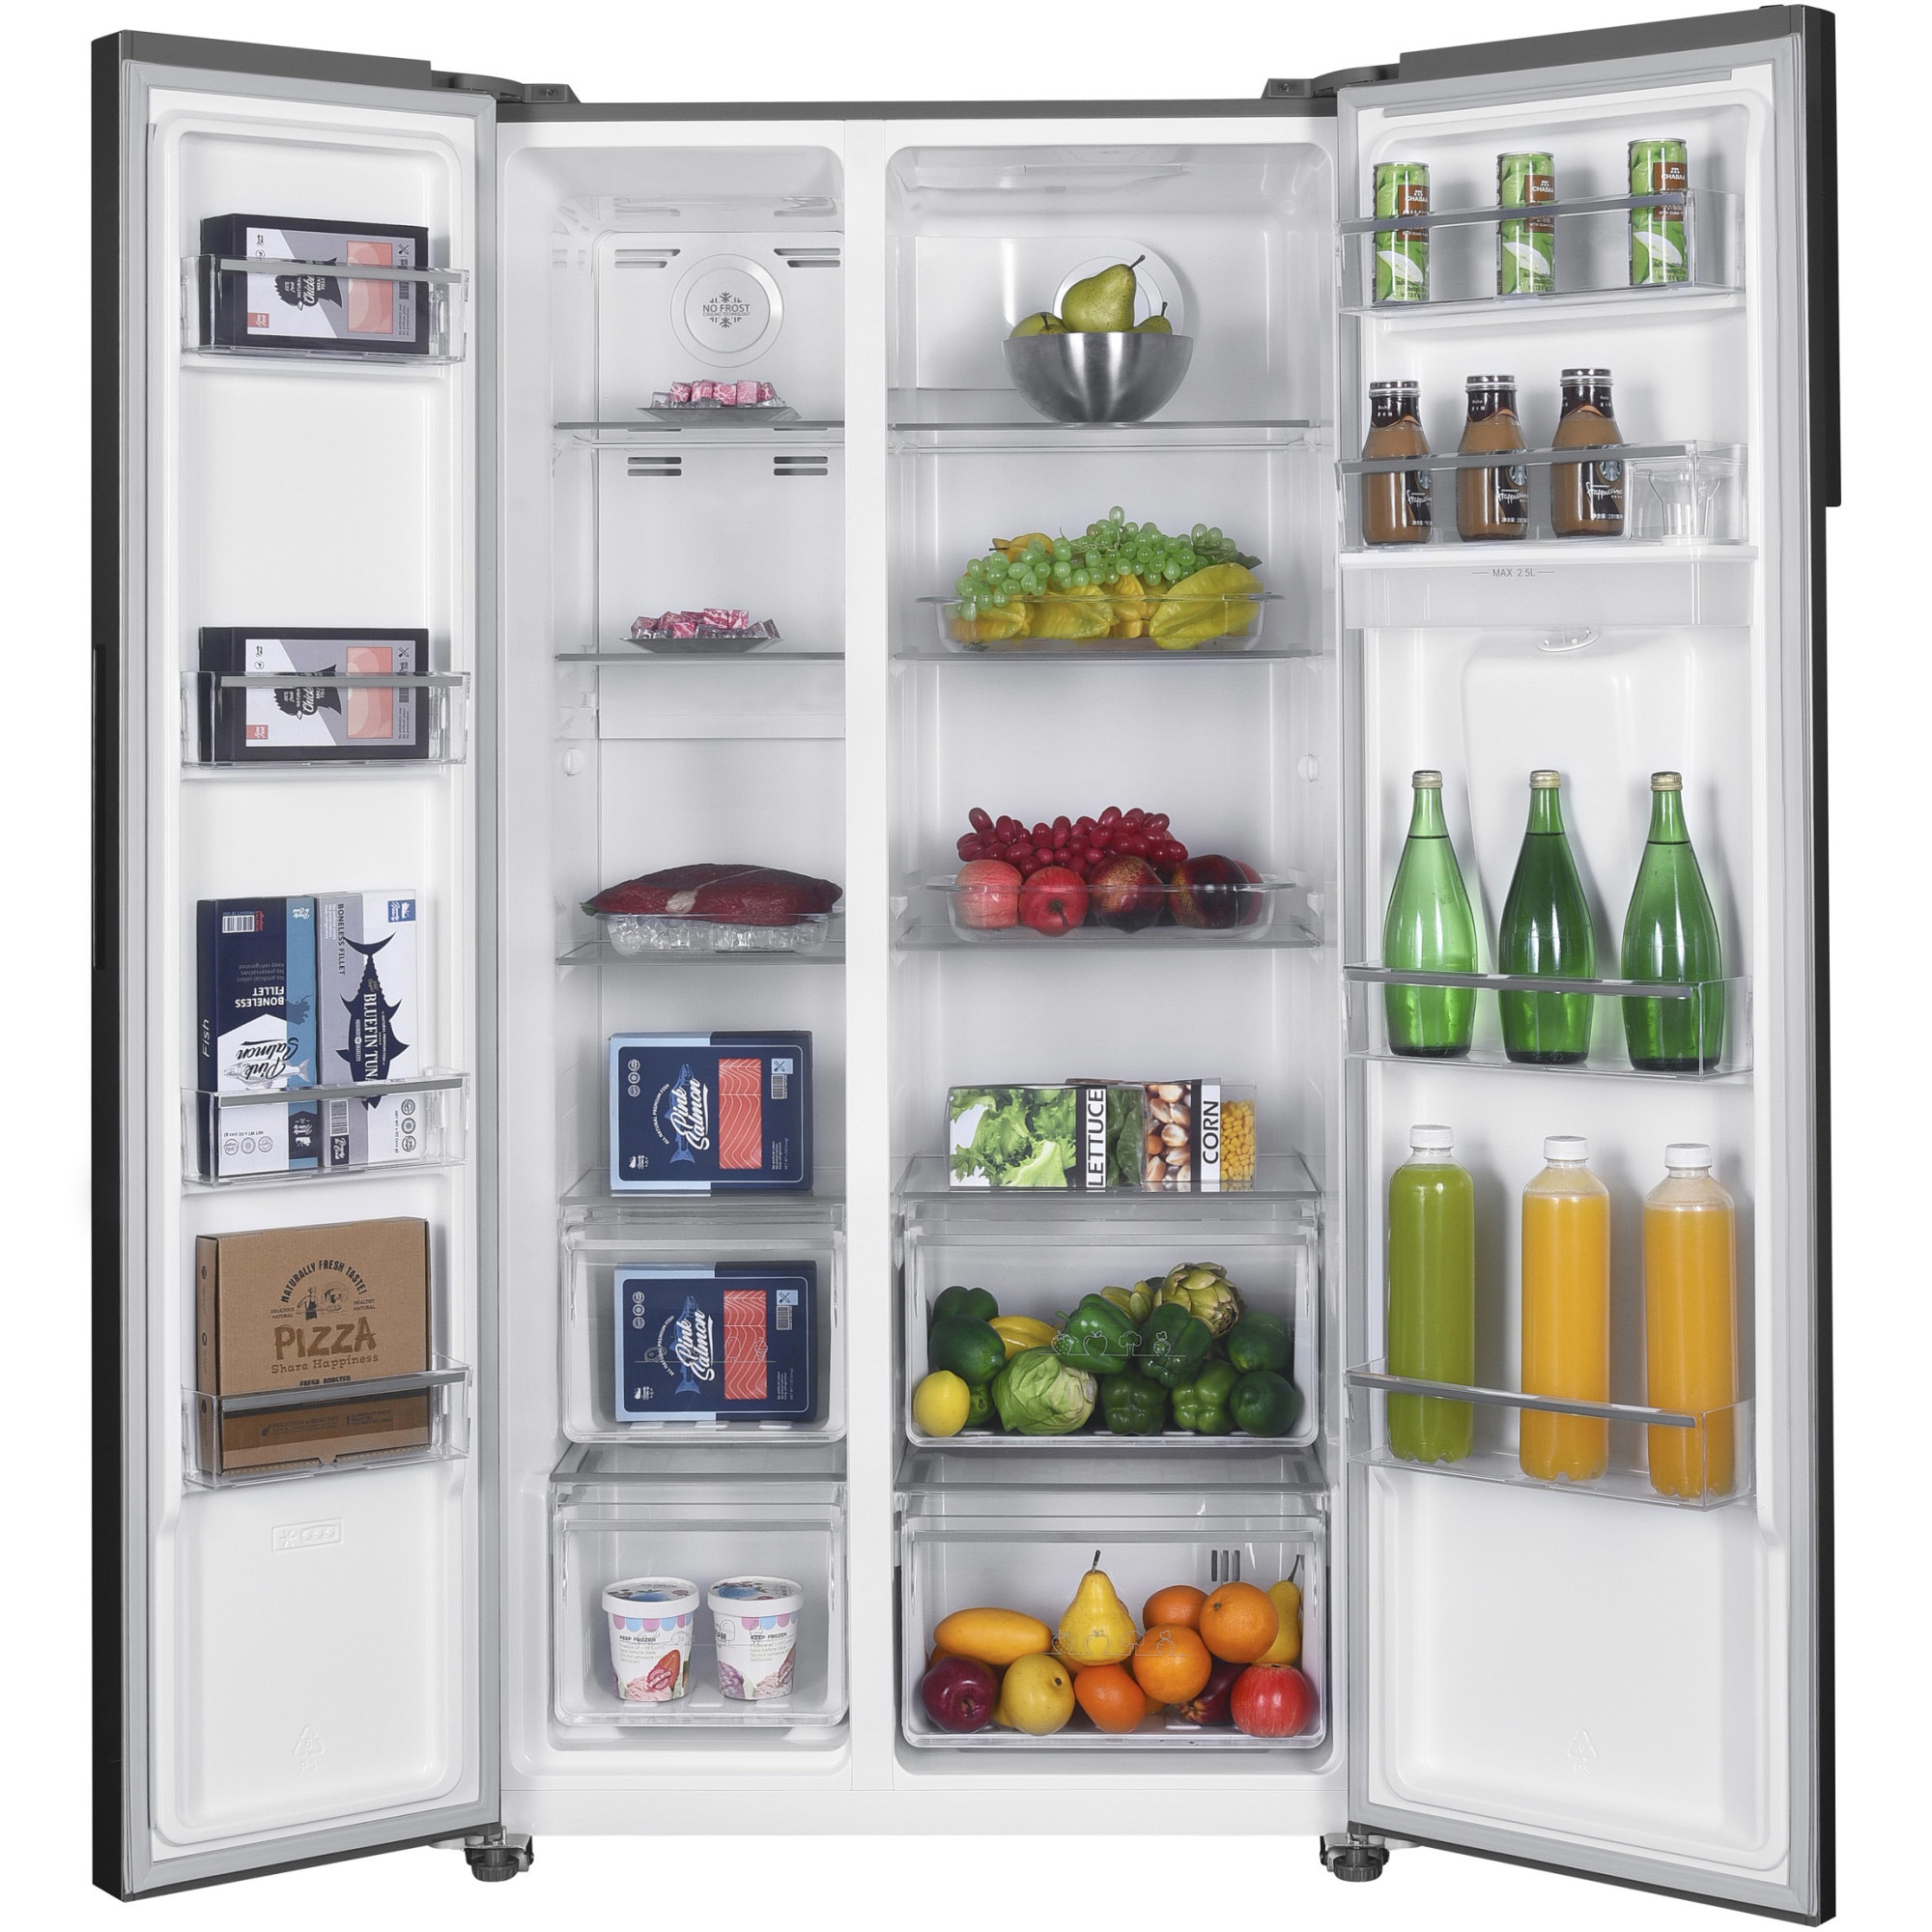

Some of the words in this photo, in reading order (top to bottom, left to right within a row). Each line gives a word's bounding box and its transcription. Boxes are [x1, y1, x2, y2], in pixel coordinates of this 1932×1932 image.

[721, 303, 751, 312] FROST
[1492, 568, 1513, 578] MAX
[1517, 568, 1535, 578] 2.5L
[235, 997, 284, 1009] BONELESS
[252, 986, 284, 996] FILLET
[363, 993, 377, 1047] BLUEFIN
[236, 1037, 298, 1061] Salmon
[243, 1057, 286, 1080] Pink
[659, 1083, 669, 1094] FISH
[653, 1092, 662, 1115] PREMIUM
[670, 1086, 694, 1135] Pink
[686, 1078, 710, 1150] Salmon
[653, 1117, 663, 1138] NATURAL
[1088, 1090, 1104, 1186] LETTUCE
[1203, 1100, 1219, 1164] CORN
[281, 1263, 316, 1302] NATURALLY
[319, 1259, 345, 1272] FRESH
[273, 1316, 377, 1360] PIZZA
[658, 1323, 667, 1347] PREMIUM
[665, 1316, 674, 1325] FISH
[675, 1318, 698, 1366] Pink
[691, 1310, 715, 1380] Salmon
[271, 1364, 308, 1374] Share
[313, 1354, 379, 1370] Happiness
